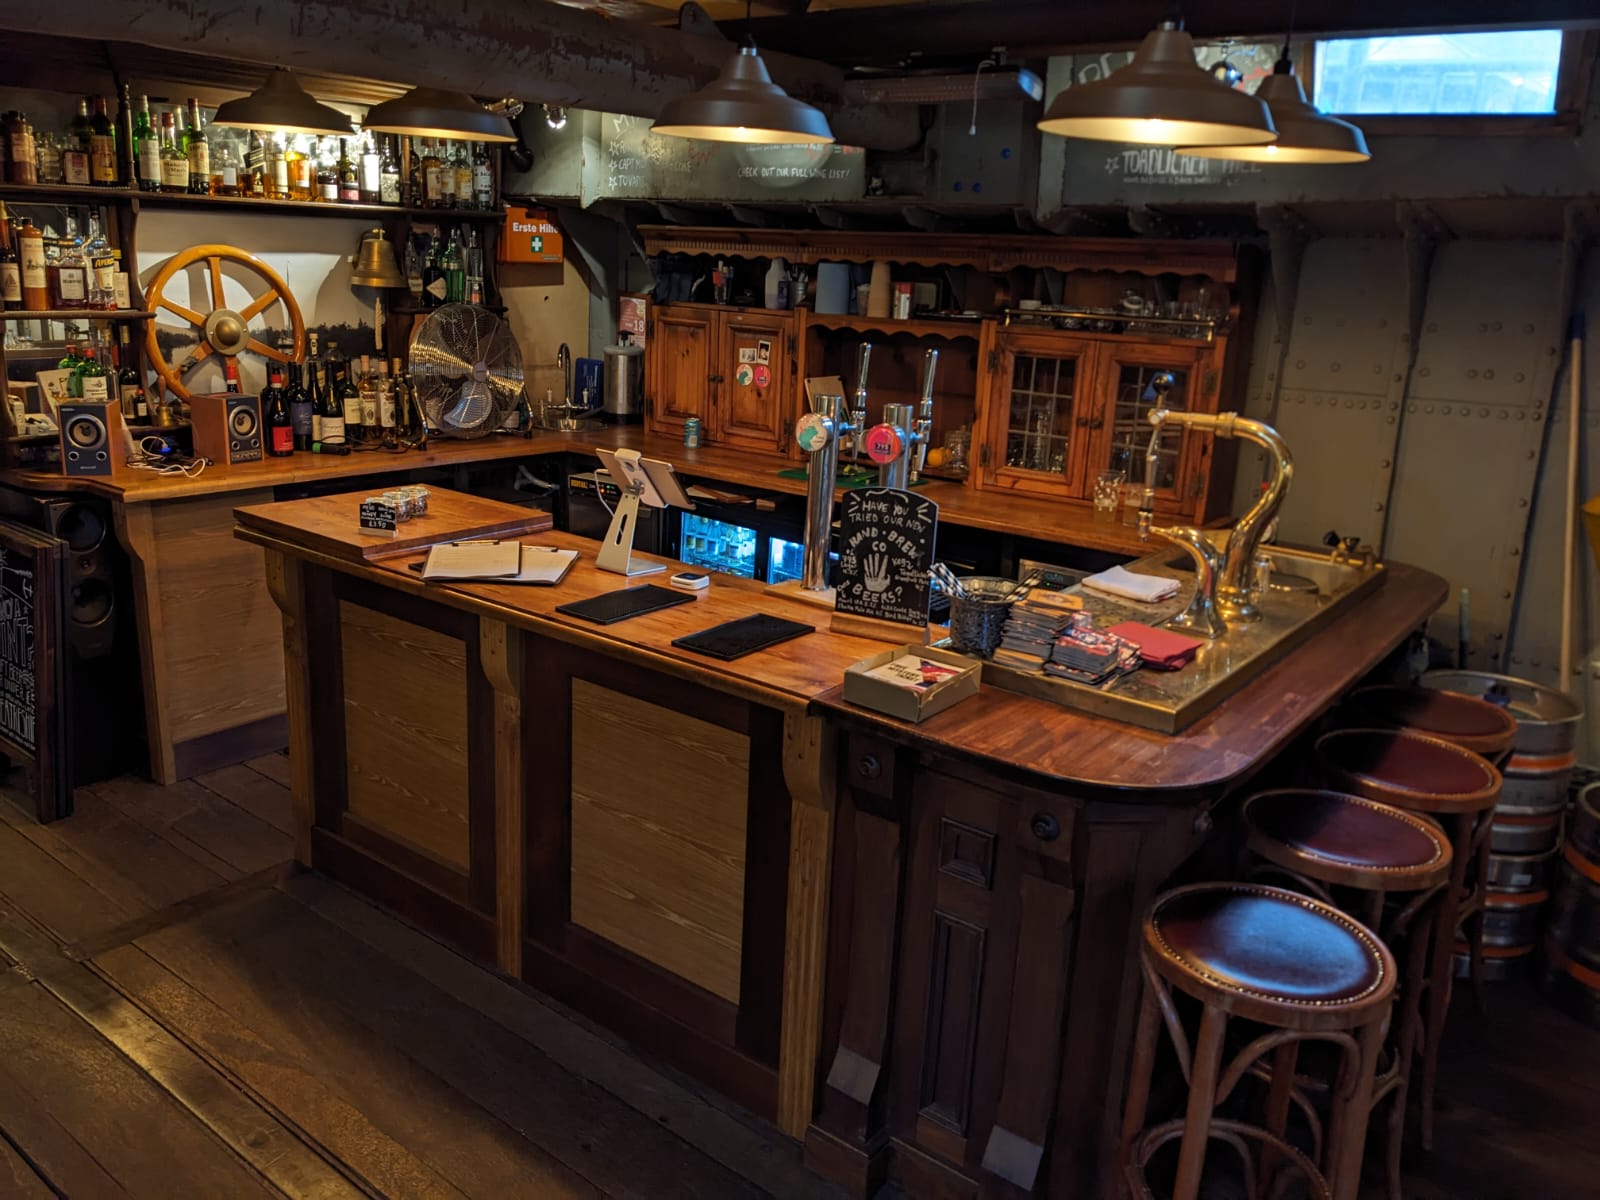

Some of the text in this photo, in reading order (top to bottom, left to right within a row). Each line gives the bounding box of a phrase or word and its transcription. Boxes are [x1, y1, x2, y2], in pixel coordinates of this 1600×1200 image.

[761, 165, 776, 177] OUT
[776, 167, 789, 177] OUR
[791, 167, 808, 178] FULL
[512, 222, 537, 233] Erste
[862, 500, 909, 516] HAVE YOU
[850, 513, 879, 523] TRIED
[883, 515, 904, 528] OUR
[849, 527, 918, 559] HAND BREW
[871, 540, 887, 551] CO
[852, 583, 903, 604] BEERS?
